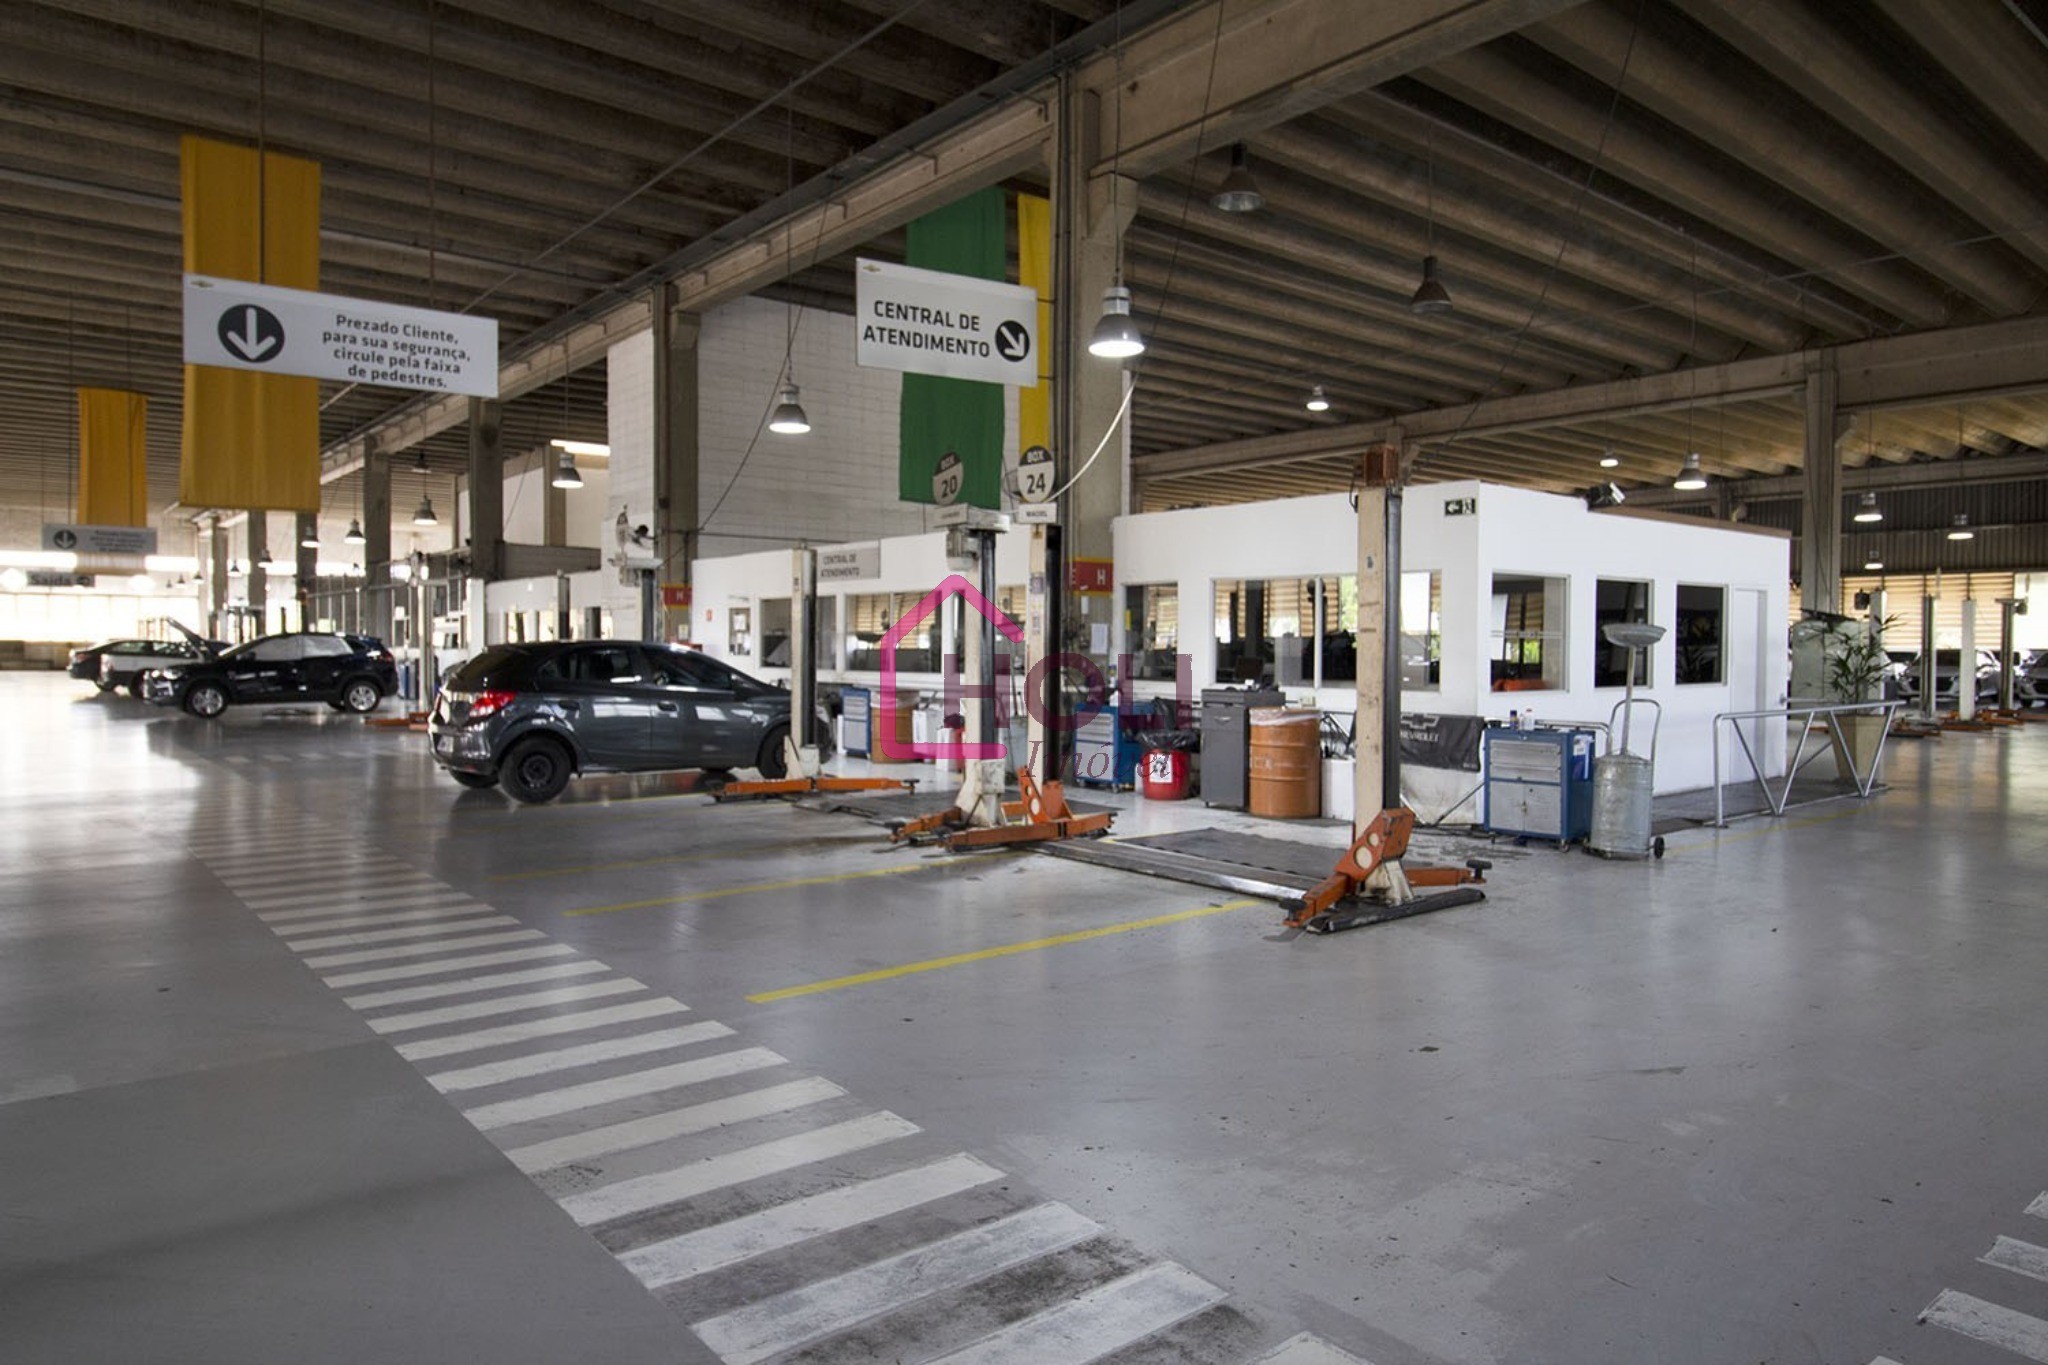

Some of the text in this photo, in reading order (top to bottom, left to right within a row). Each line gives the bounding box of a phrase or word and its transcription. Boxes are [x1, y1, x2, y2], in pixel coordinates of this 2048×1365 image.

[336, 314, 459, 345] Prezado Cliente,
[874, 300, 980, 332] CENTRAL DE
[323, 331, 471, 362] para sua segurança,
[863, 325, 990, 358] ATENDIMENTO
[333, 346, 461, 374] circule pela faixa
[348, 363, 448, 388] de pedestres.
[941, 475, 958, 499] 20
[1026, 472, 1046, 495] 24
[1097, 568, 1106, 585] H
